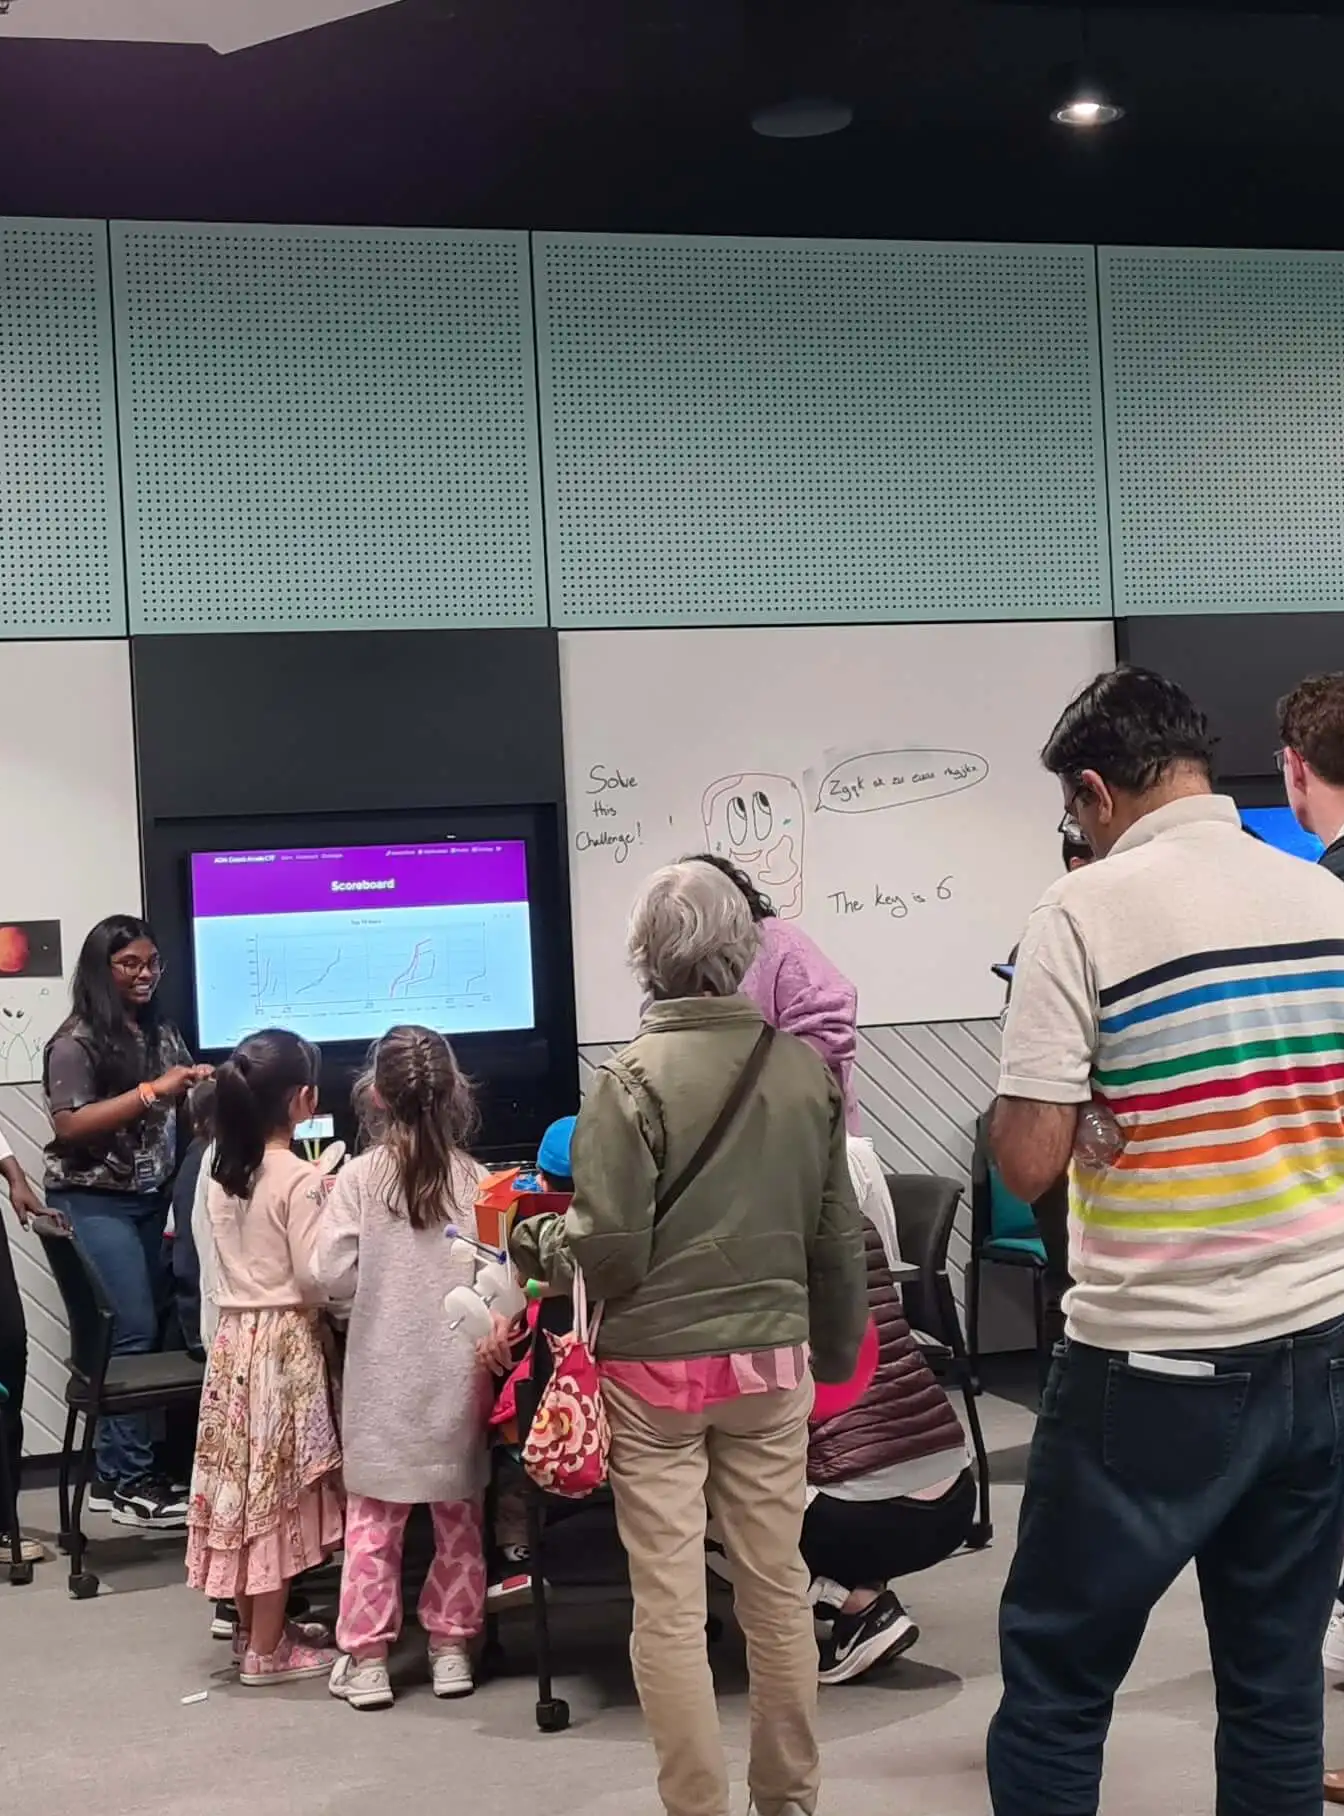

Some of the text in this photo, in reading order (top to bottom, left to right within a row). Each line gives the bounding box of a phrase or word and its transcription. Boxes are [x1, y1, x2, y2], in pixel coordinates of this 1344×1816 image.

[585, 764, 638, 795] Solve
[592, 800, 617, 818] this
[575, 820, 644, 864] Challenge!
[331, 878, 396, 893] Scoreboard
[825, 889, 865, 914] The
[874, 883, 909, 919] key
[935, 875, 955, 901] 6
